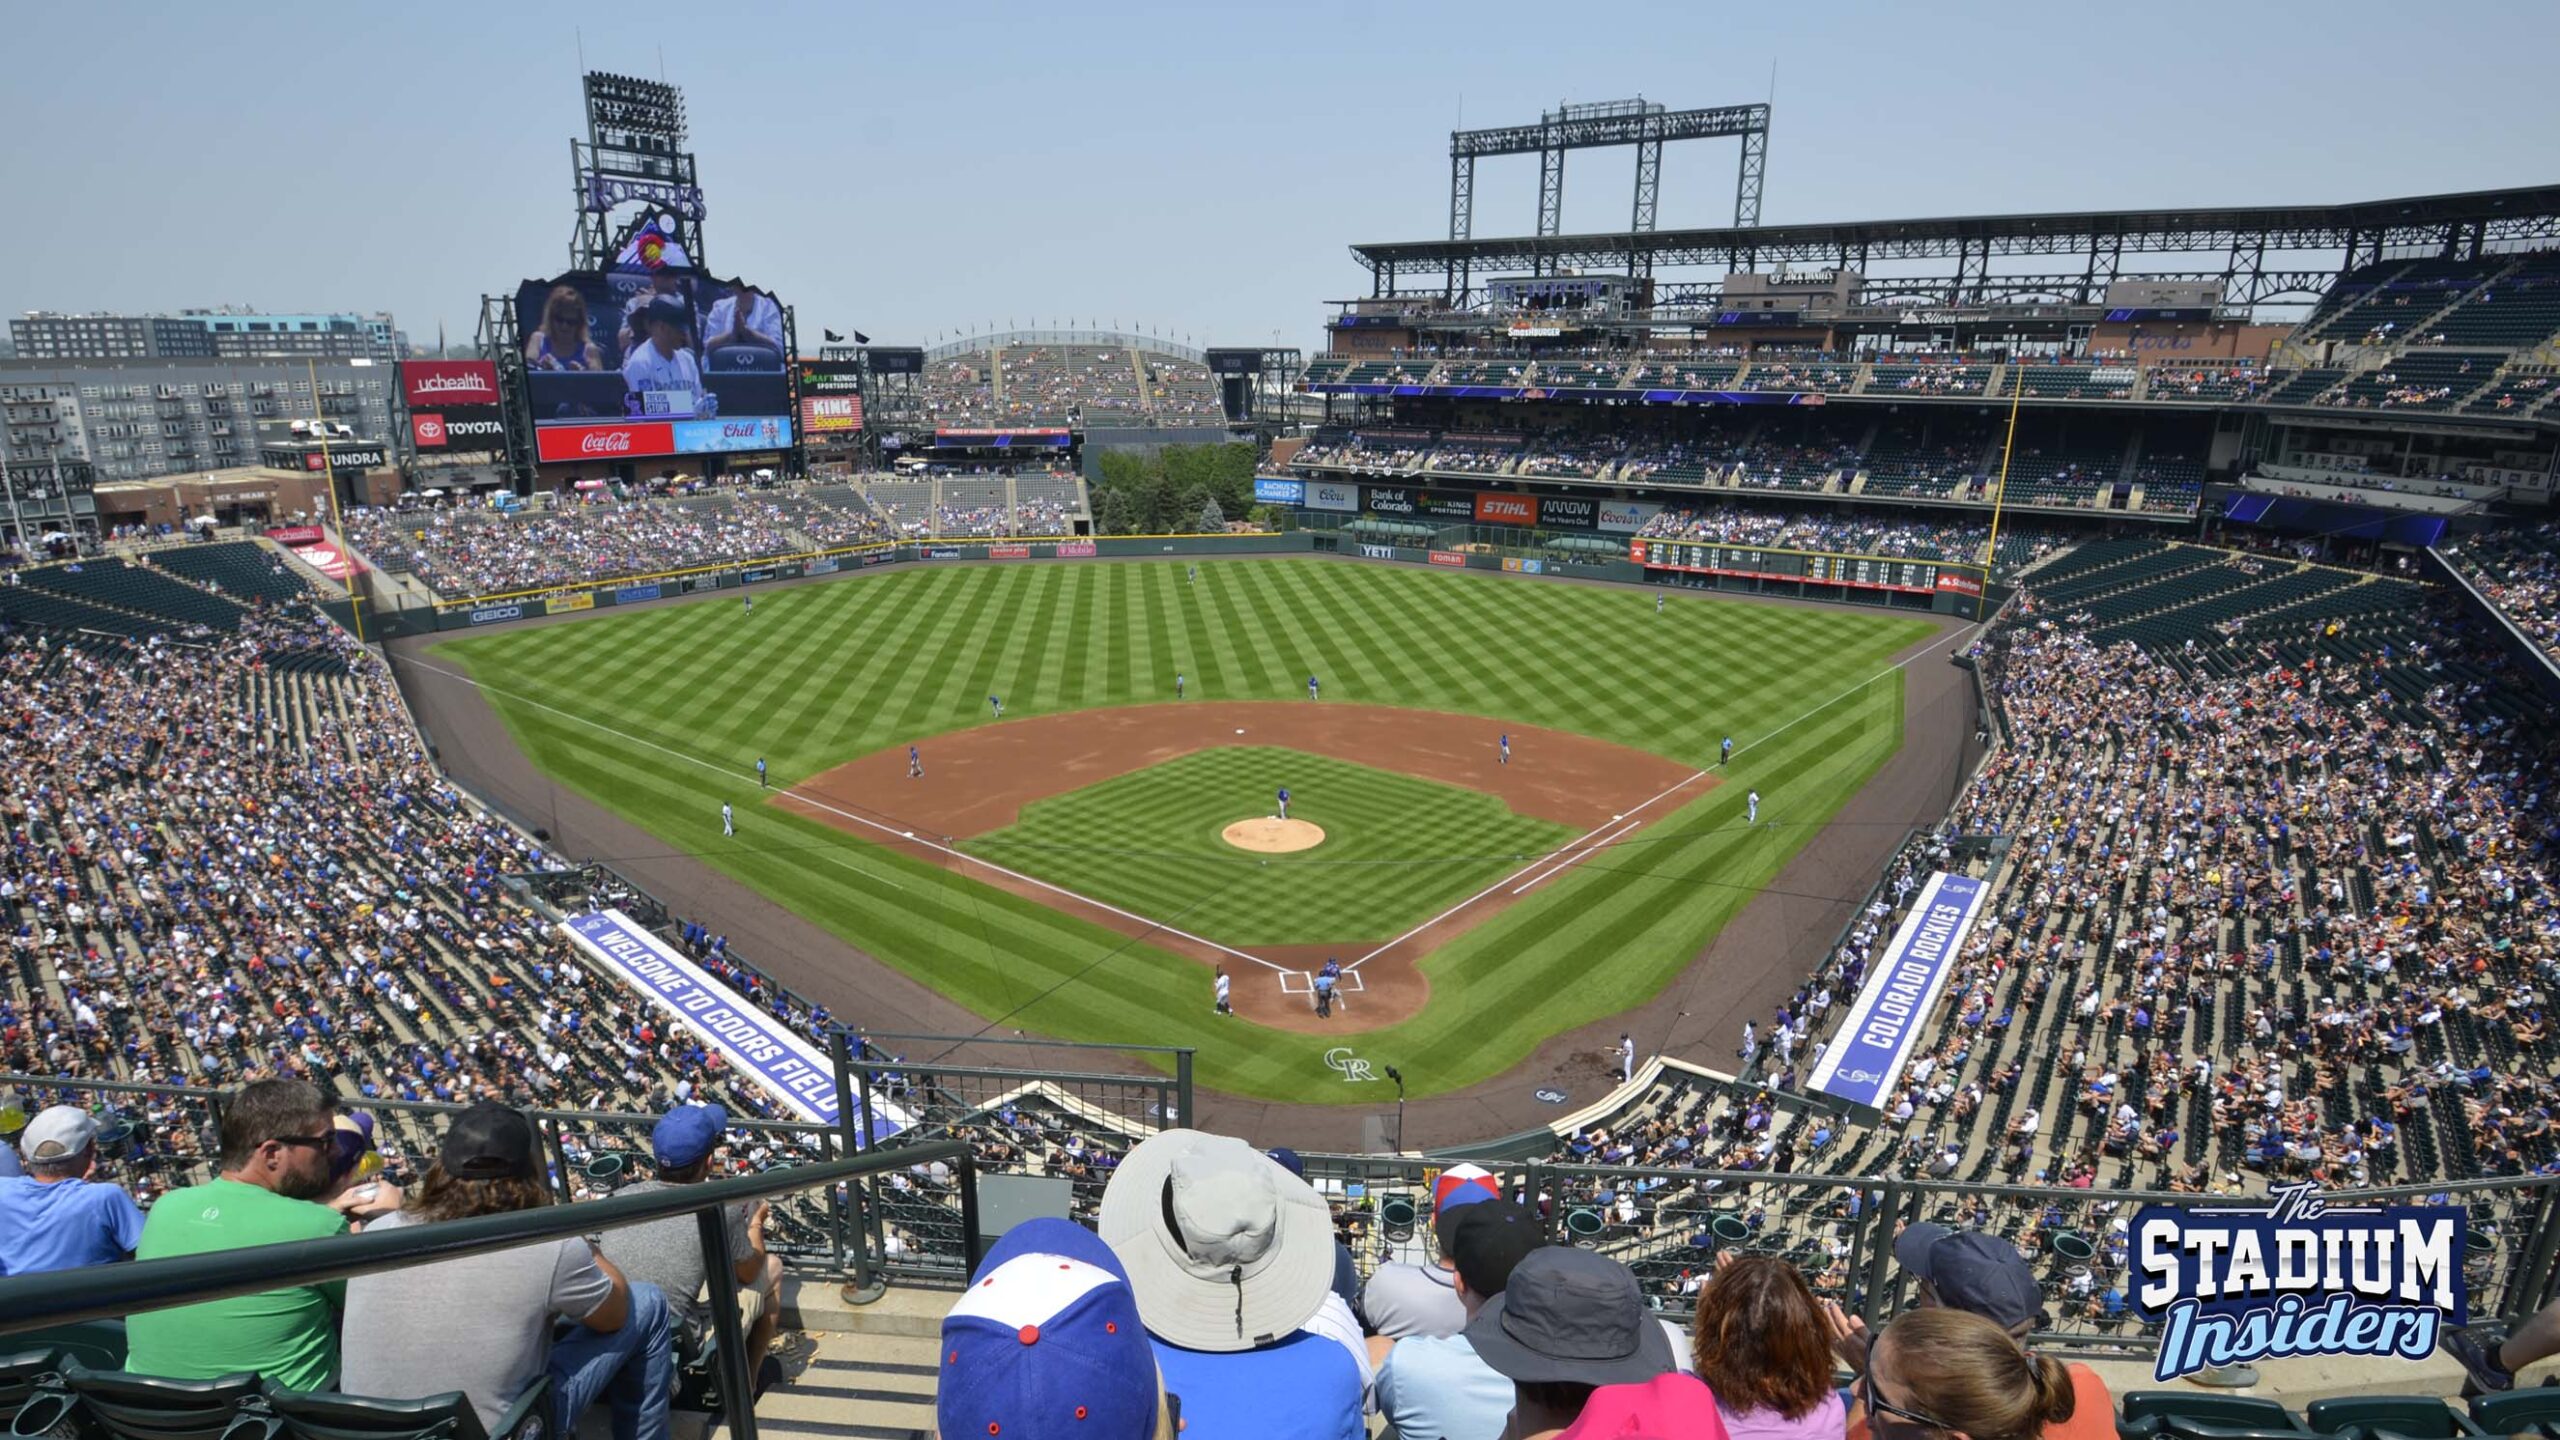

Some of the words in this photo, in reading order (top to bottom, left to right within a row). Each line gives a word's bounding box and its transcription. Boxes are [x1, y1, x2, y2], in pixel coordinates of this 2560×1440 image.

[418, 372, 486, 391] uchealth
[812, 399, 852, 415] KING
[445, 421, 504, 435] TOYOTA
[723, 423, 757, 438] Chill
[582, 432, 631, 453] Coca-Cola
[1371, 489, 1394, 500] Bank
[1394, 489, 1406, 501] of
[1370, 499, 1412, 512] Colorado
[1483, 501, 1529, 515] STIHL
[1543, 515, 1556, 523] Five
[1557, 516, 1576, 525] Years
[1576, 518, 1589, 526] Out
[1601, 510, 1632, 525] Coors
[1363, 545, 1392, 558] YETI
[472, 606, 520, 622] GEICO
[1861, 961, 1931, 1049] COLORADO
[1909, 904, 1961, 962] ROCKIES
[597, 929, 691, 993] WELCOME
[675, 988, 717, 1012] TO
[701, 1008, 784, 1062] COORS
[769, 1057, 838, 1112] FIELD
